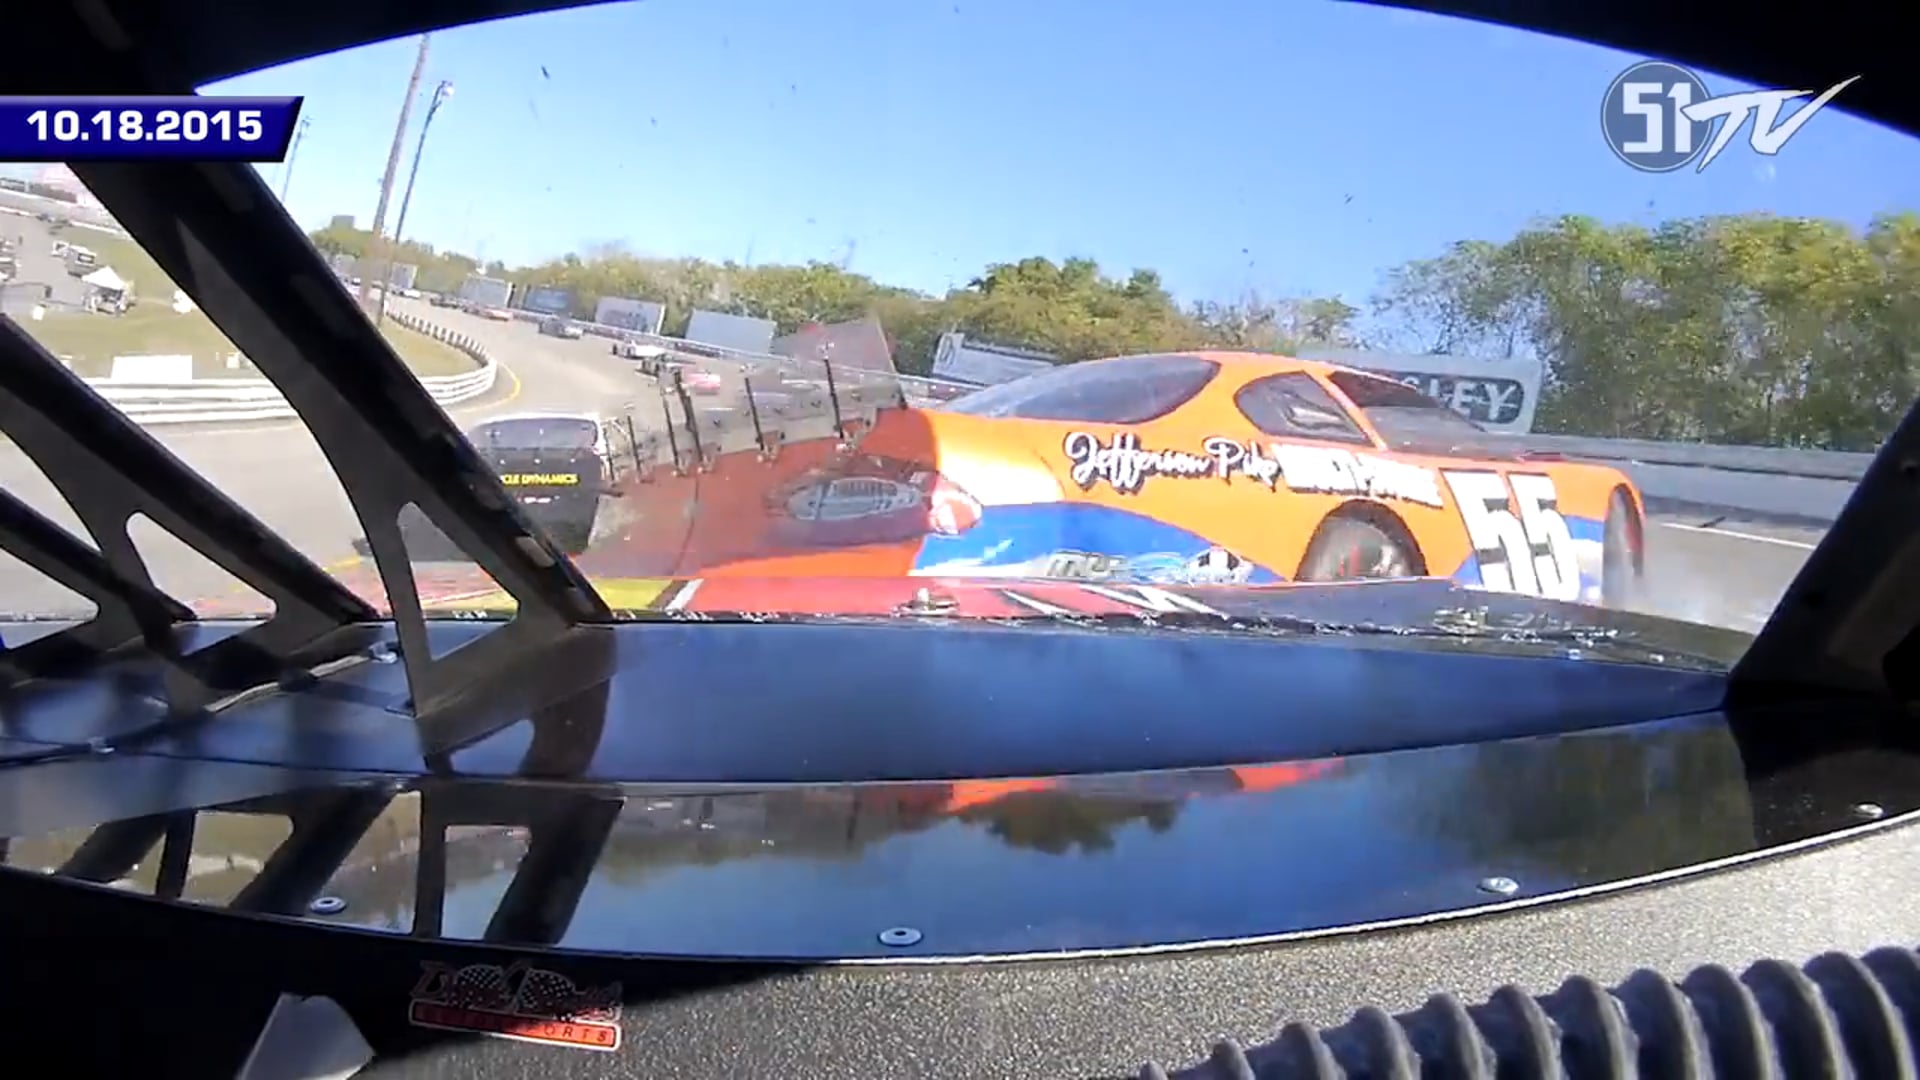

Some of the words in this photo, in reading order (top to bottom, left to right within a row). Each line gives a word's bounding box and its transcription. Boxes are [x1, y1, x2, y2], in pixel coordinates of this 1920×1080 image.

[521, 473, 579, 485] DYNAMICS
[1062, 431, 1213, 494] Jefferson
[1439, 467, 1581, 602] 55
